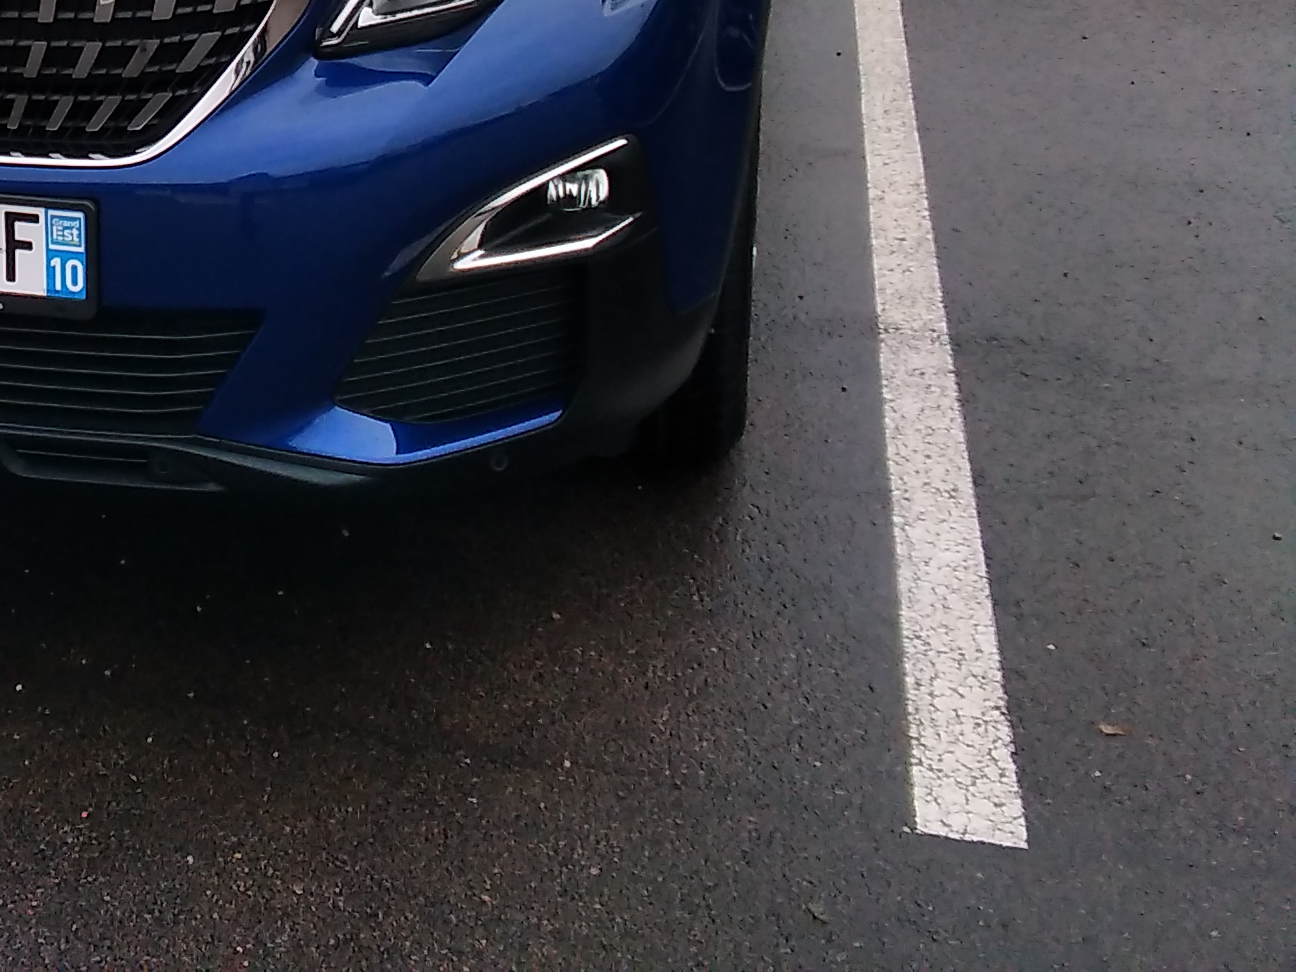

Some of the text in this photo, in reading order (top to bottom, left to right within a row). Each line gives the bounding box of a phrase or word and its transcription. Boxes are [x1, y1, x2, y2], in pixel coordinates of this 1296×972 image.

[52, 218, 80, 228] Grand
[52, 226, 80, 242] Est
[50, 257, 84, 293] 10
